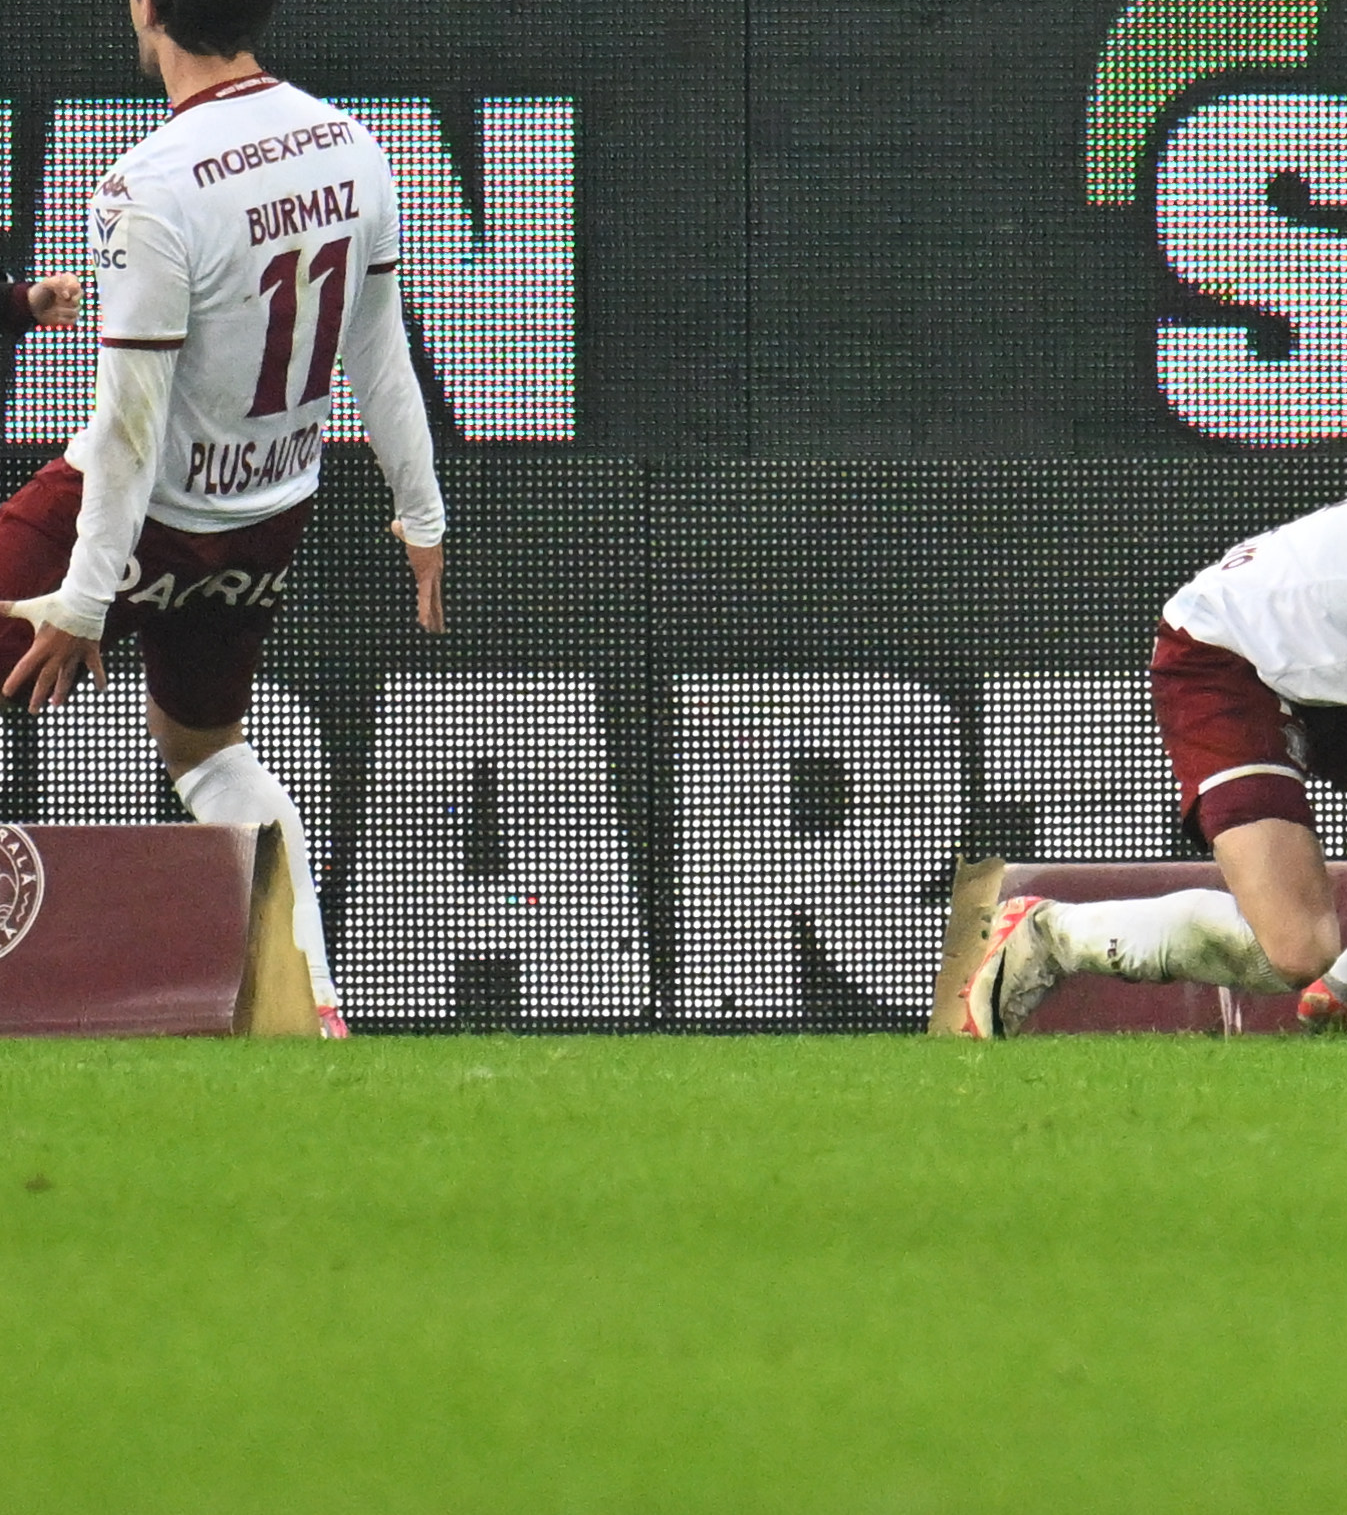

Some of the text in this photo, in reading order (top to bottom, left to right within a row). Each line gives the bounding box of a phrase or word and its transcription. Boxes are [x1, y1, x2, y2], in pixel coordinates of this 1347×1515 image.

[192, 122, 355, 188] MOBEXPERT
[246, 180, 360, 247] BURMAZ
[244, 236, 352, 418] 11
